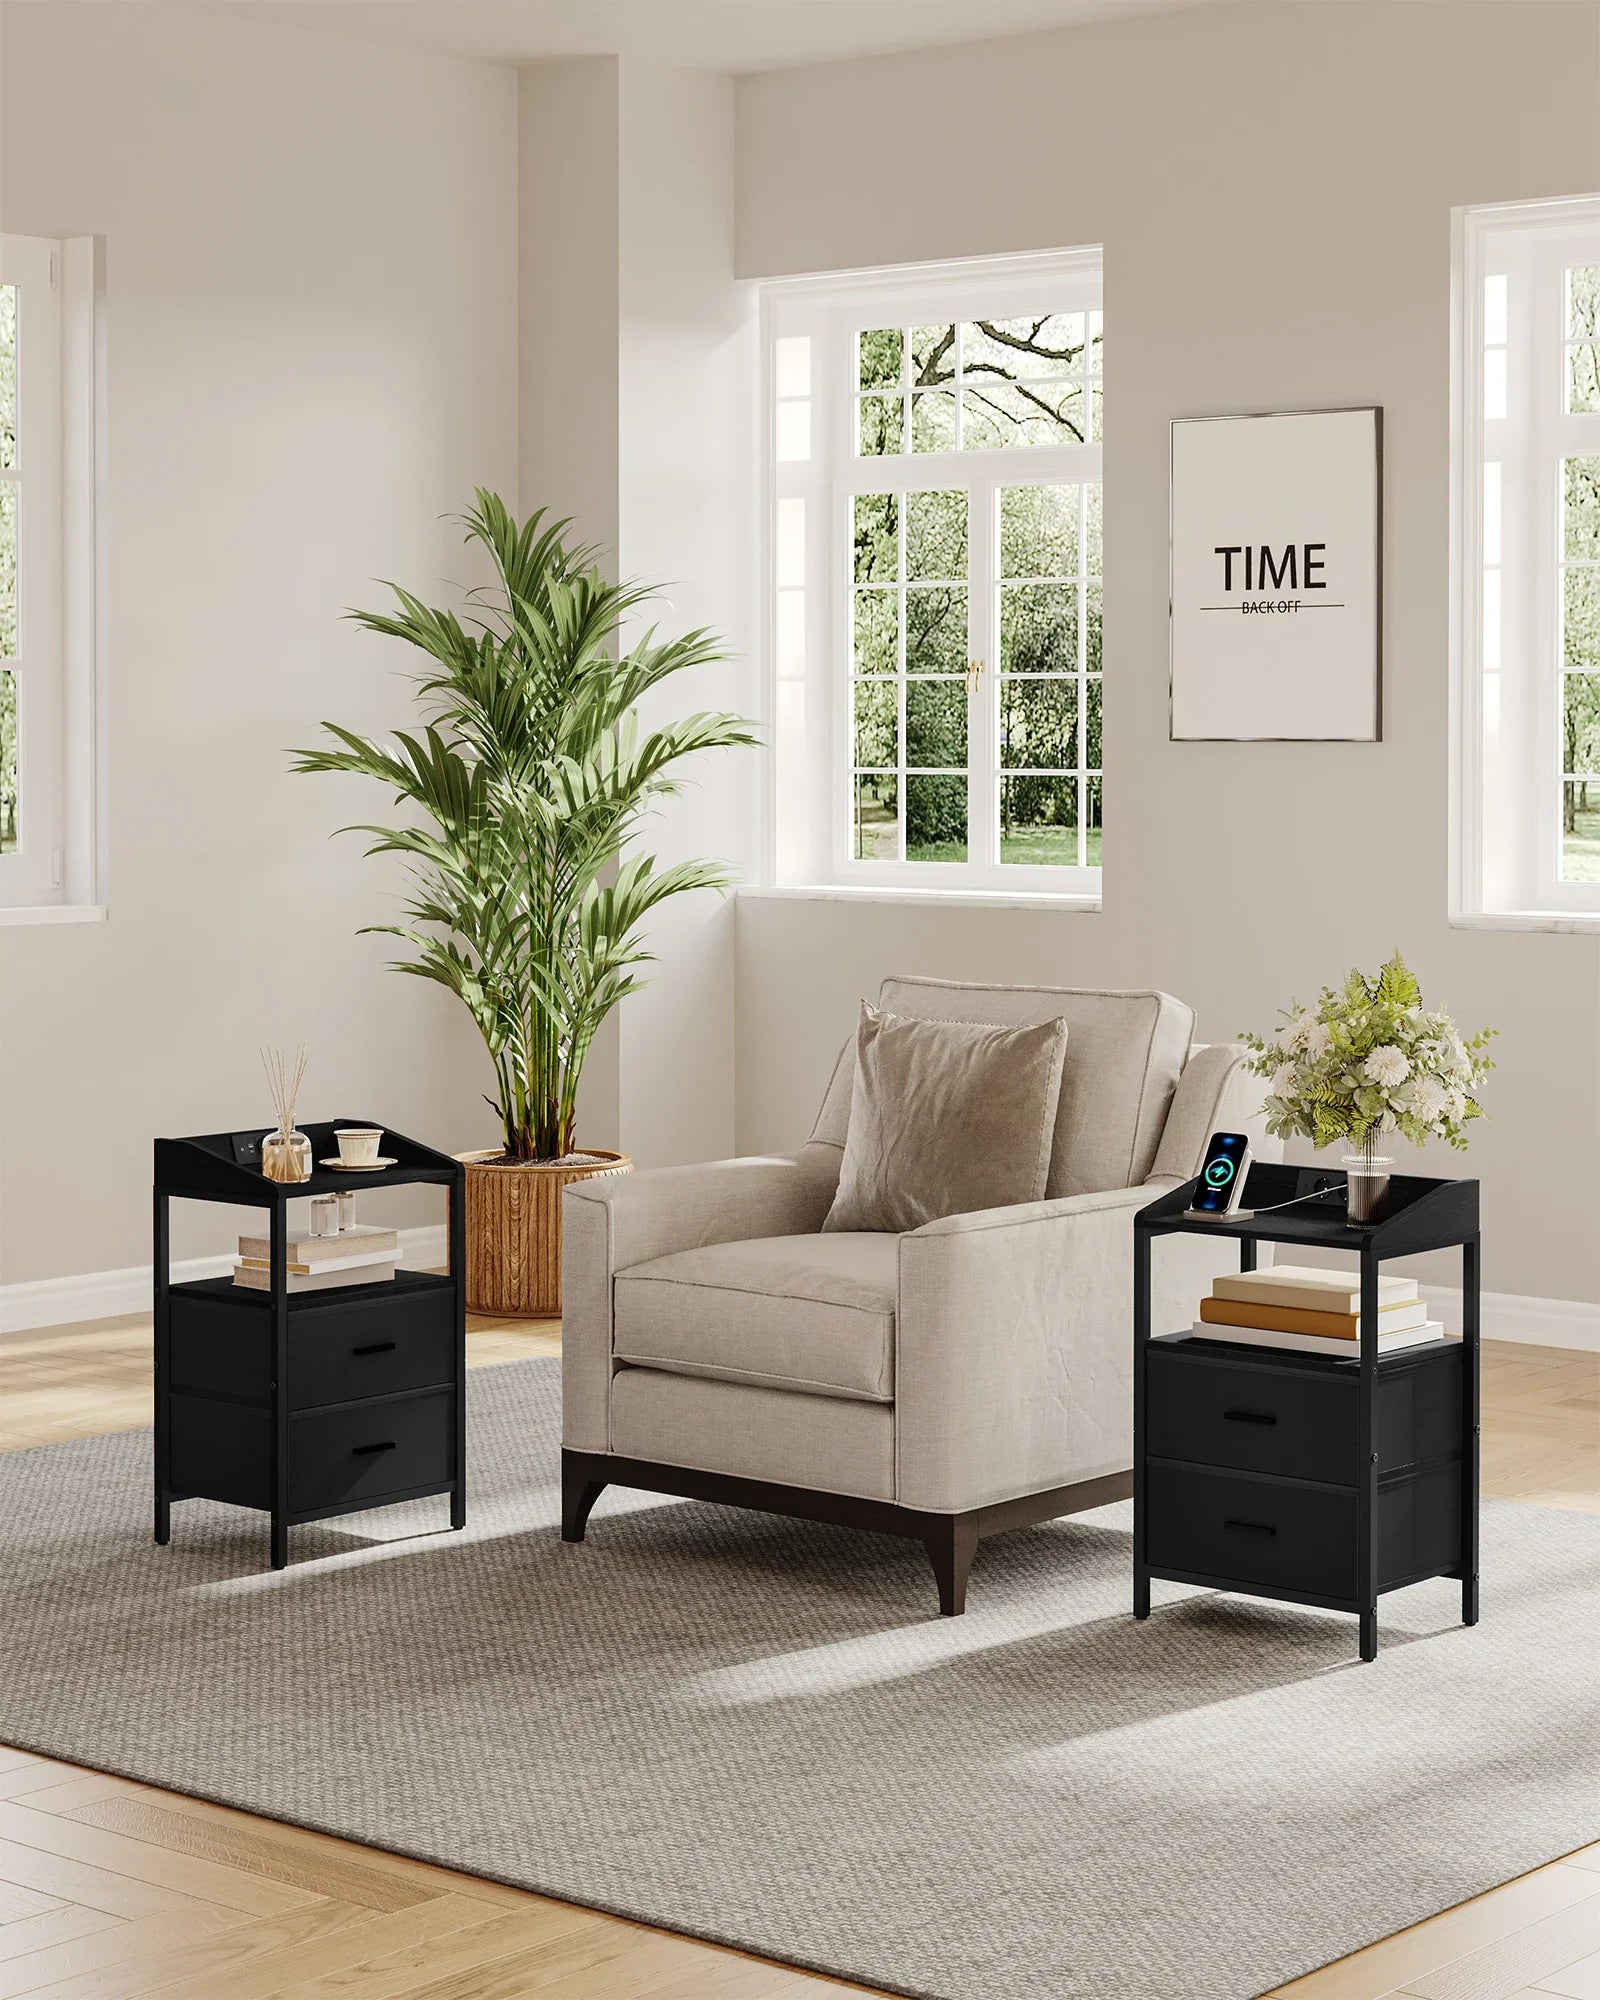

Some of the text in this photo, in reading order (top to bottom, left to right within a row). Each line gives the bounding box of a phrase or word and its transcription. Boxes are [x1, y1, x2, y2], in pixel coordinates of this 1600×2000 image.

[1214, 544, 1327, 591] TIME
[1242, 600, 1301, 614] BACK OFF
